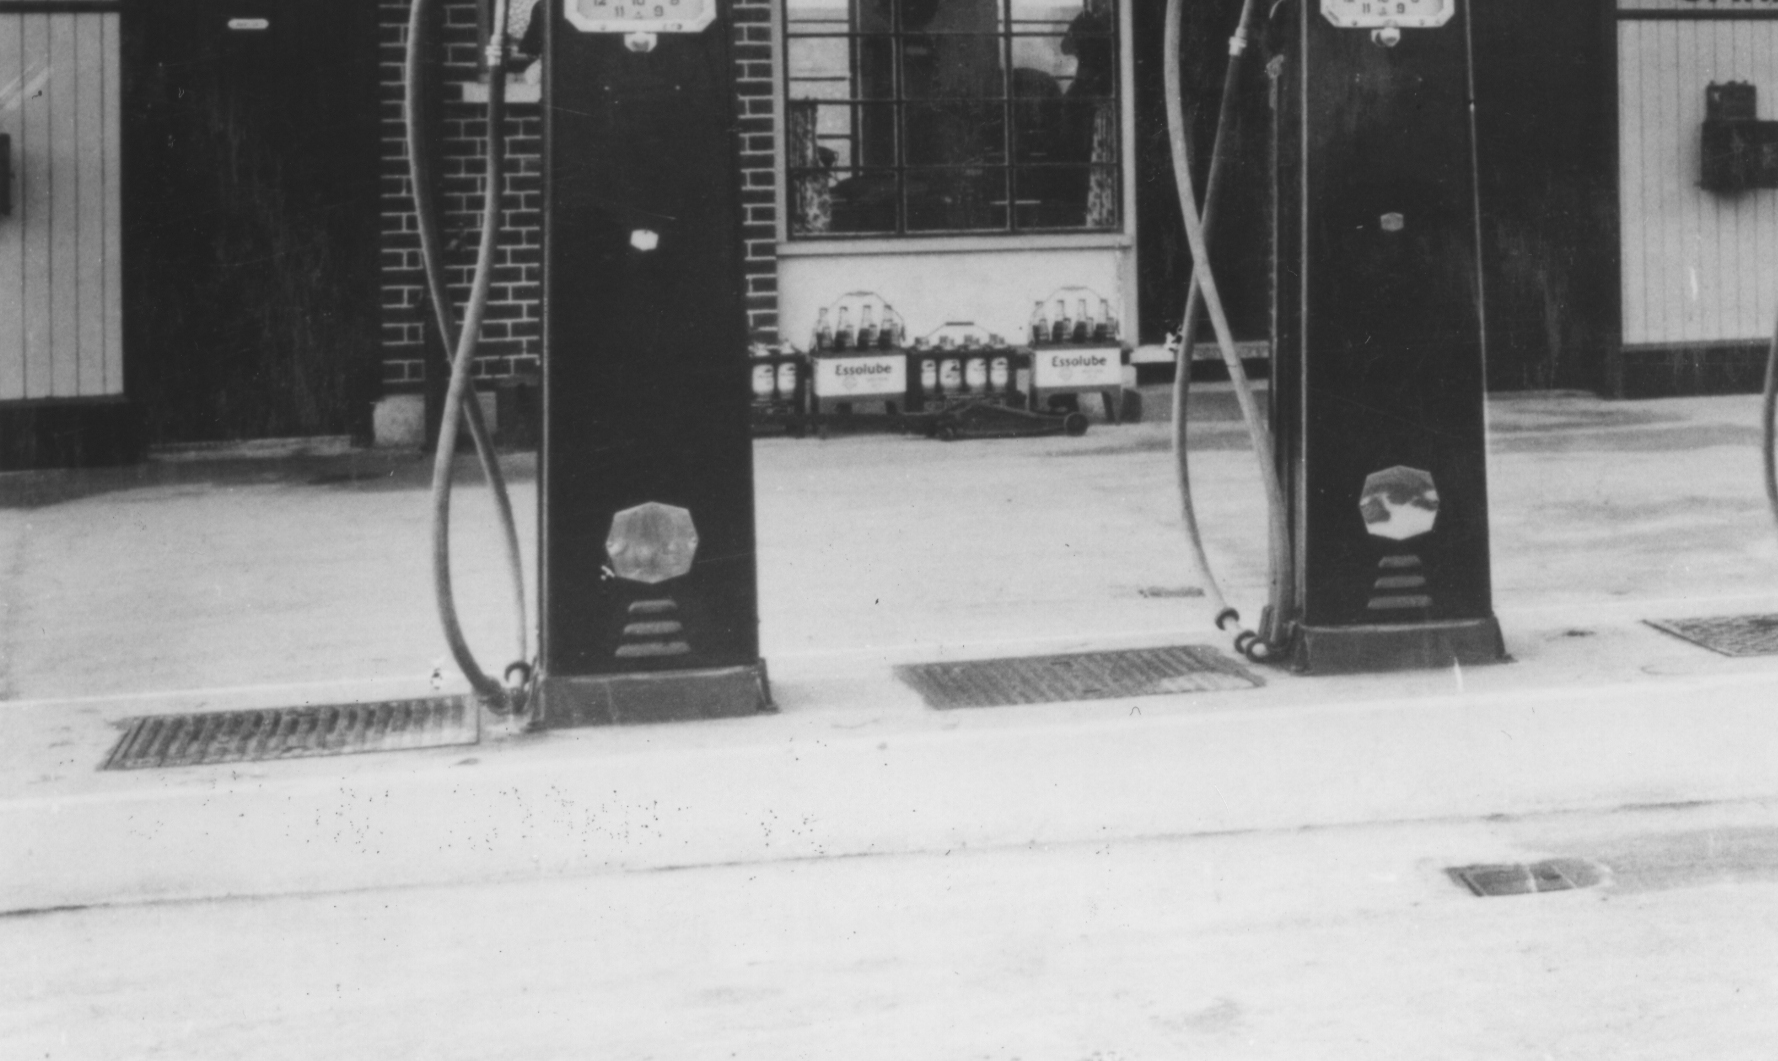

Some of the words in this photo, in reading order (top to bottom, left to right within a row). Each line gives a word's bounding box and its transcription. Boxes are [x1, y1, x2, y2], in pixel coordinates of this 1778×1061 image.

[615, 5, 625, 17] 11
[654, 5, 664, 17] 9
[1362, 3, 1371, 14] 11
[1397, 3, 1405, 14] 9
[1052, 355, 1106, 367] Essolube
[835, 363, 892, 376] Essolube
